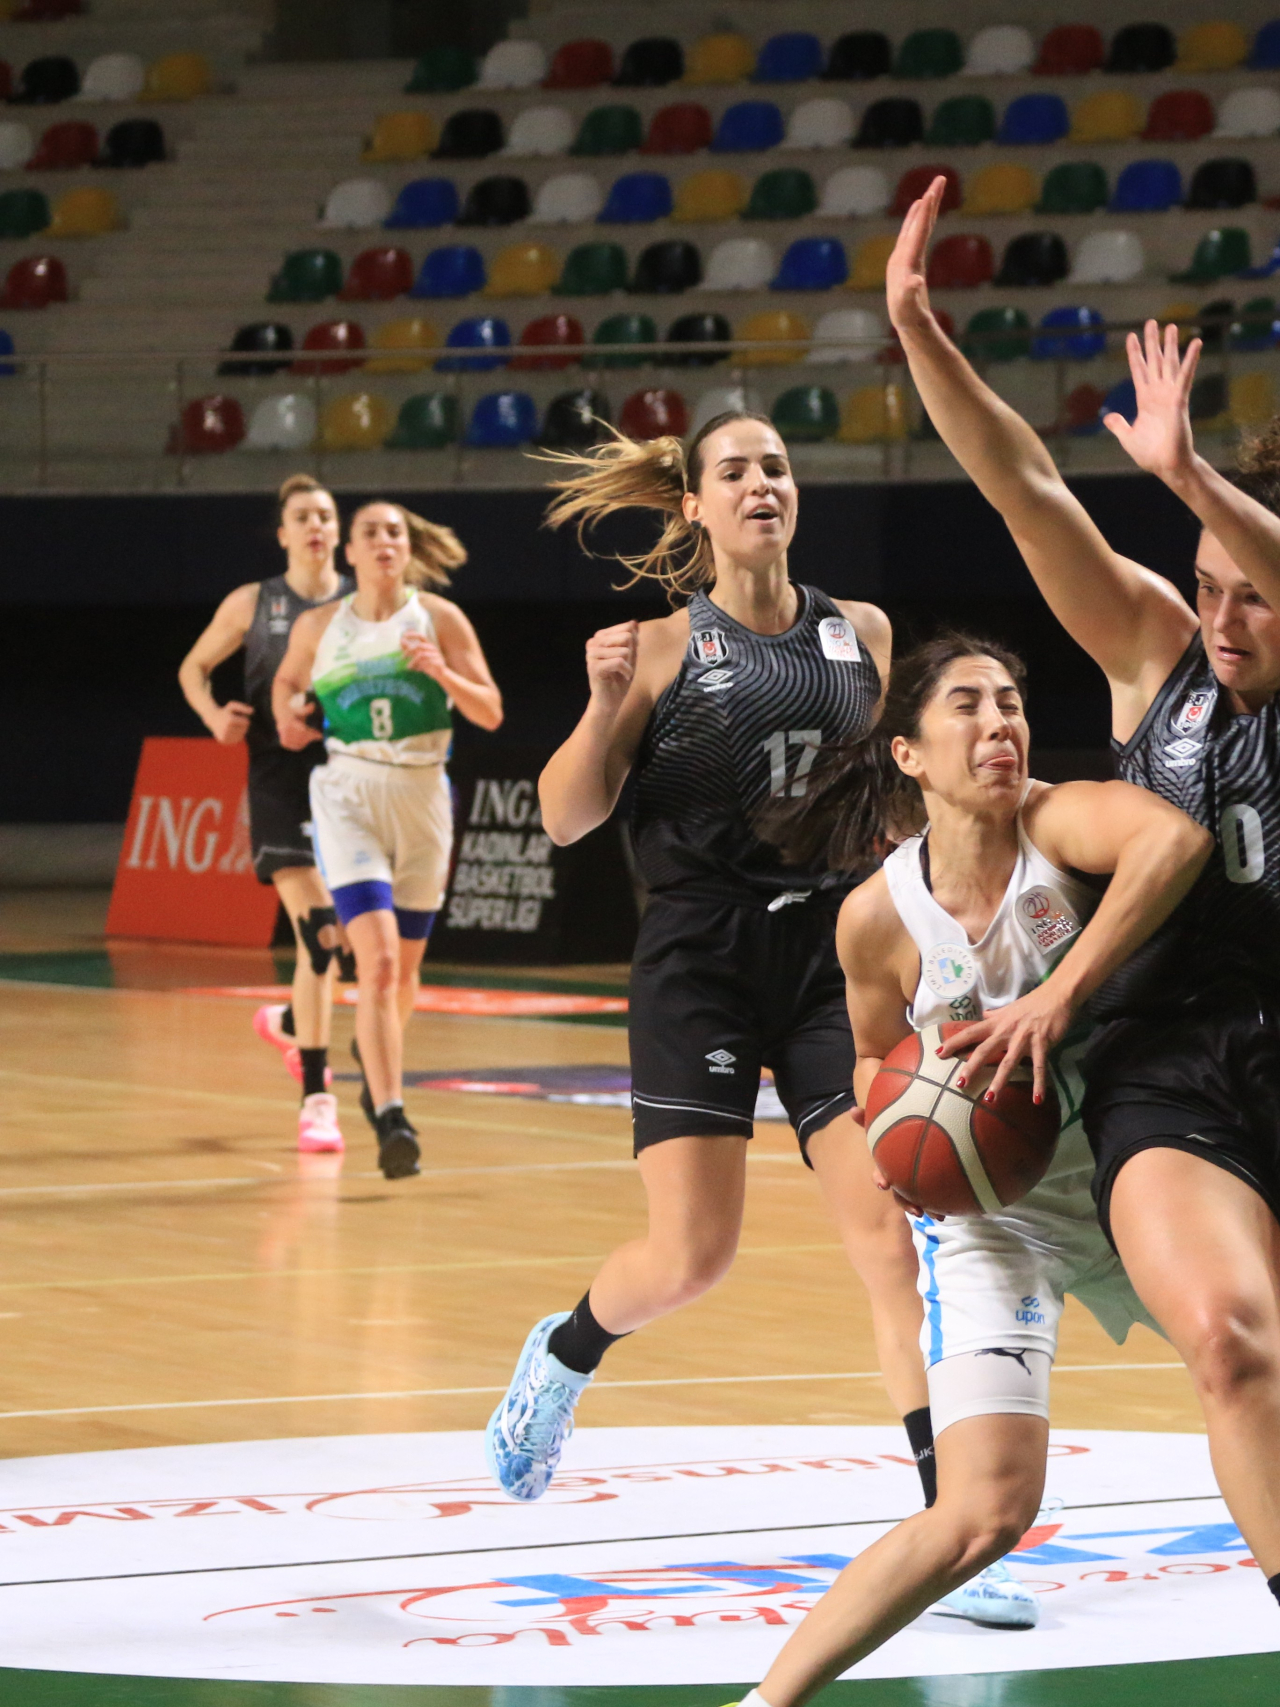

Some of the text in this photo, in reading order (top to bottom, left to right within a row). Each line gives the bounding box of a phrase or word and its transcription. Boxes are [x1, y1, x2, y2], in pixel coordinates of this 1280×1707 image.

[703, 681, 734, 693] umbro
[370, 698, 393, 739] 8
[763, 729, 822, 798] 17
[1165, 757, 1196, 768] umbro
[468, 779, 533, 828] ING
[124, 795, 222, 874] ING
[1221, 804, 1265, 884] 0
[708, 1065, 735, 1074] umbro
[1015, 1310, 1045, 1326] upon
[0, 1497, 287, 1533] İZM
